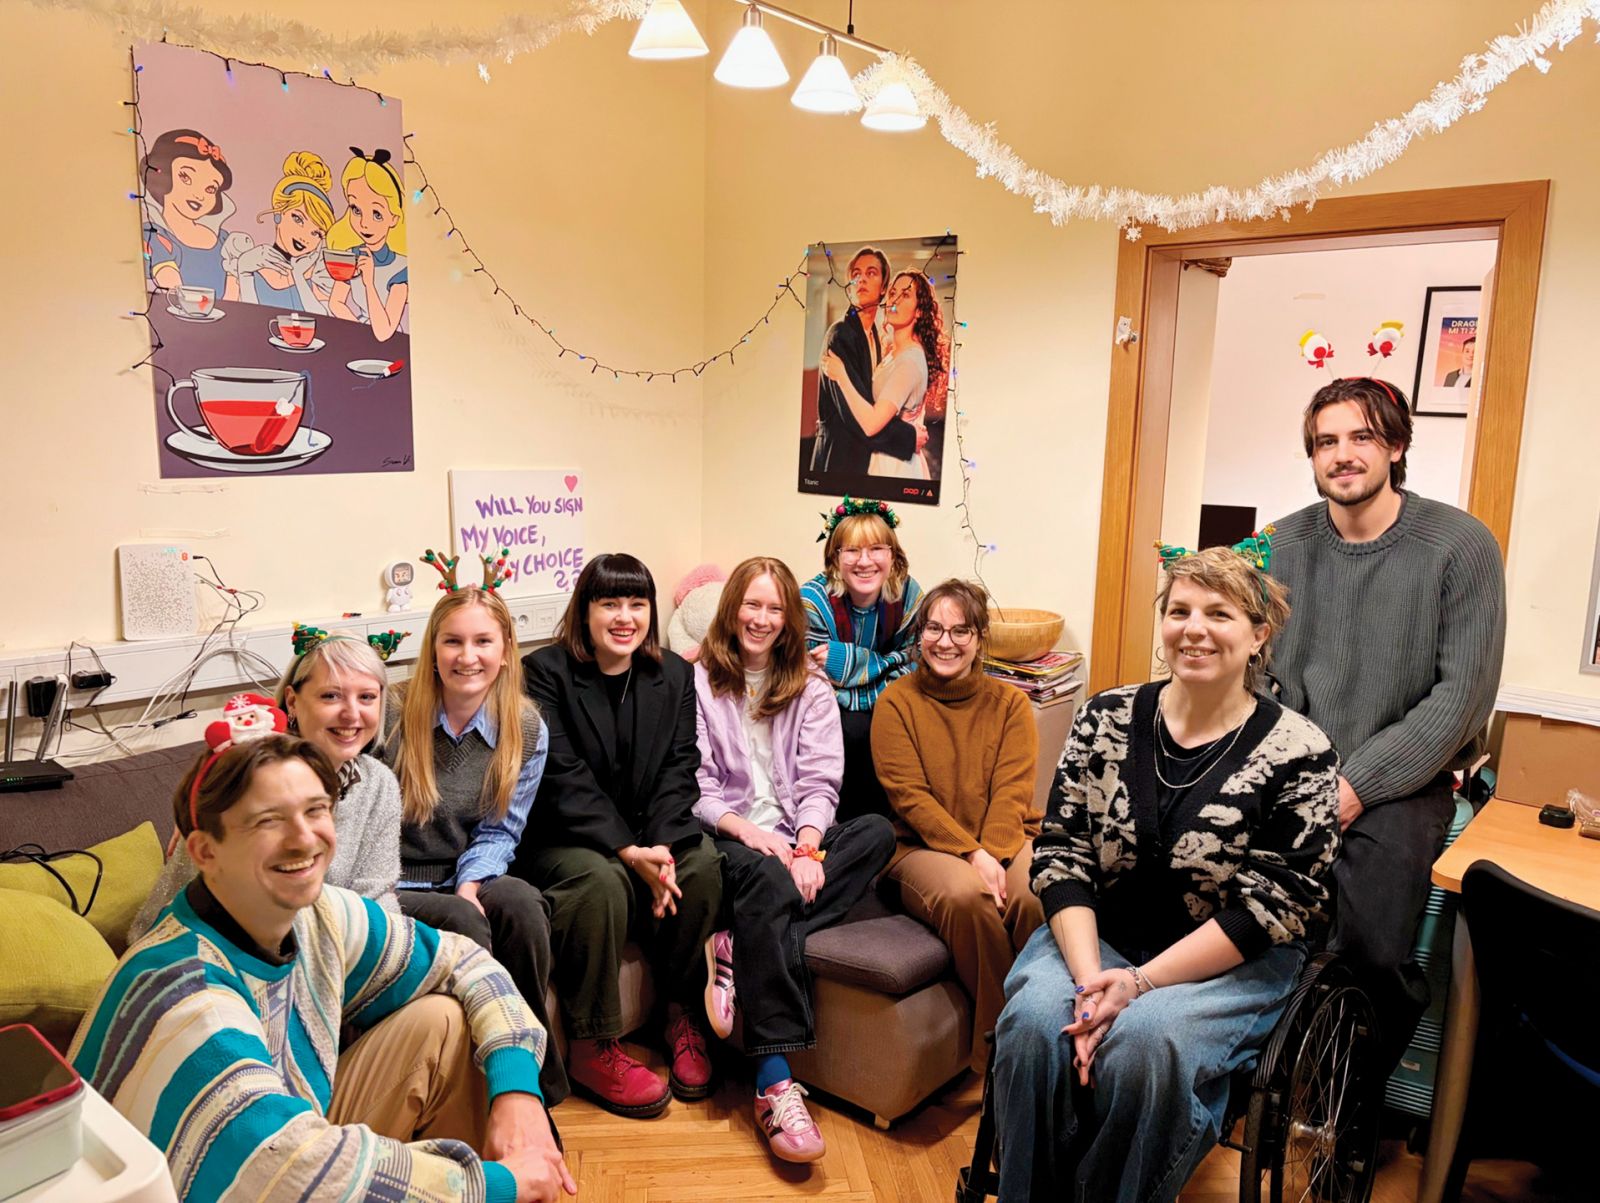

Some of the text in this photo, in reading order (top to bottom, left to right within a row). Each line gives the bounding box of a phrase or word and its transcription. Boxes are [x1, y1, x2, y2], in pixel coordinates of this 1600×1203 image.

[1448, 327, 1459, 335] MI
[903, 487, 919, 495] pop
[475, 494, 583, 519] WILL YOU SIGN
[460, 525, 546, 553] MY VOICE,
[523, 548, 583, 575] CHOICE
